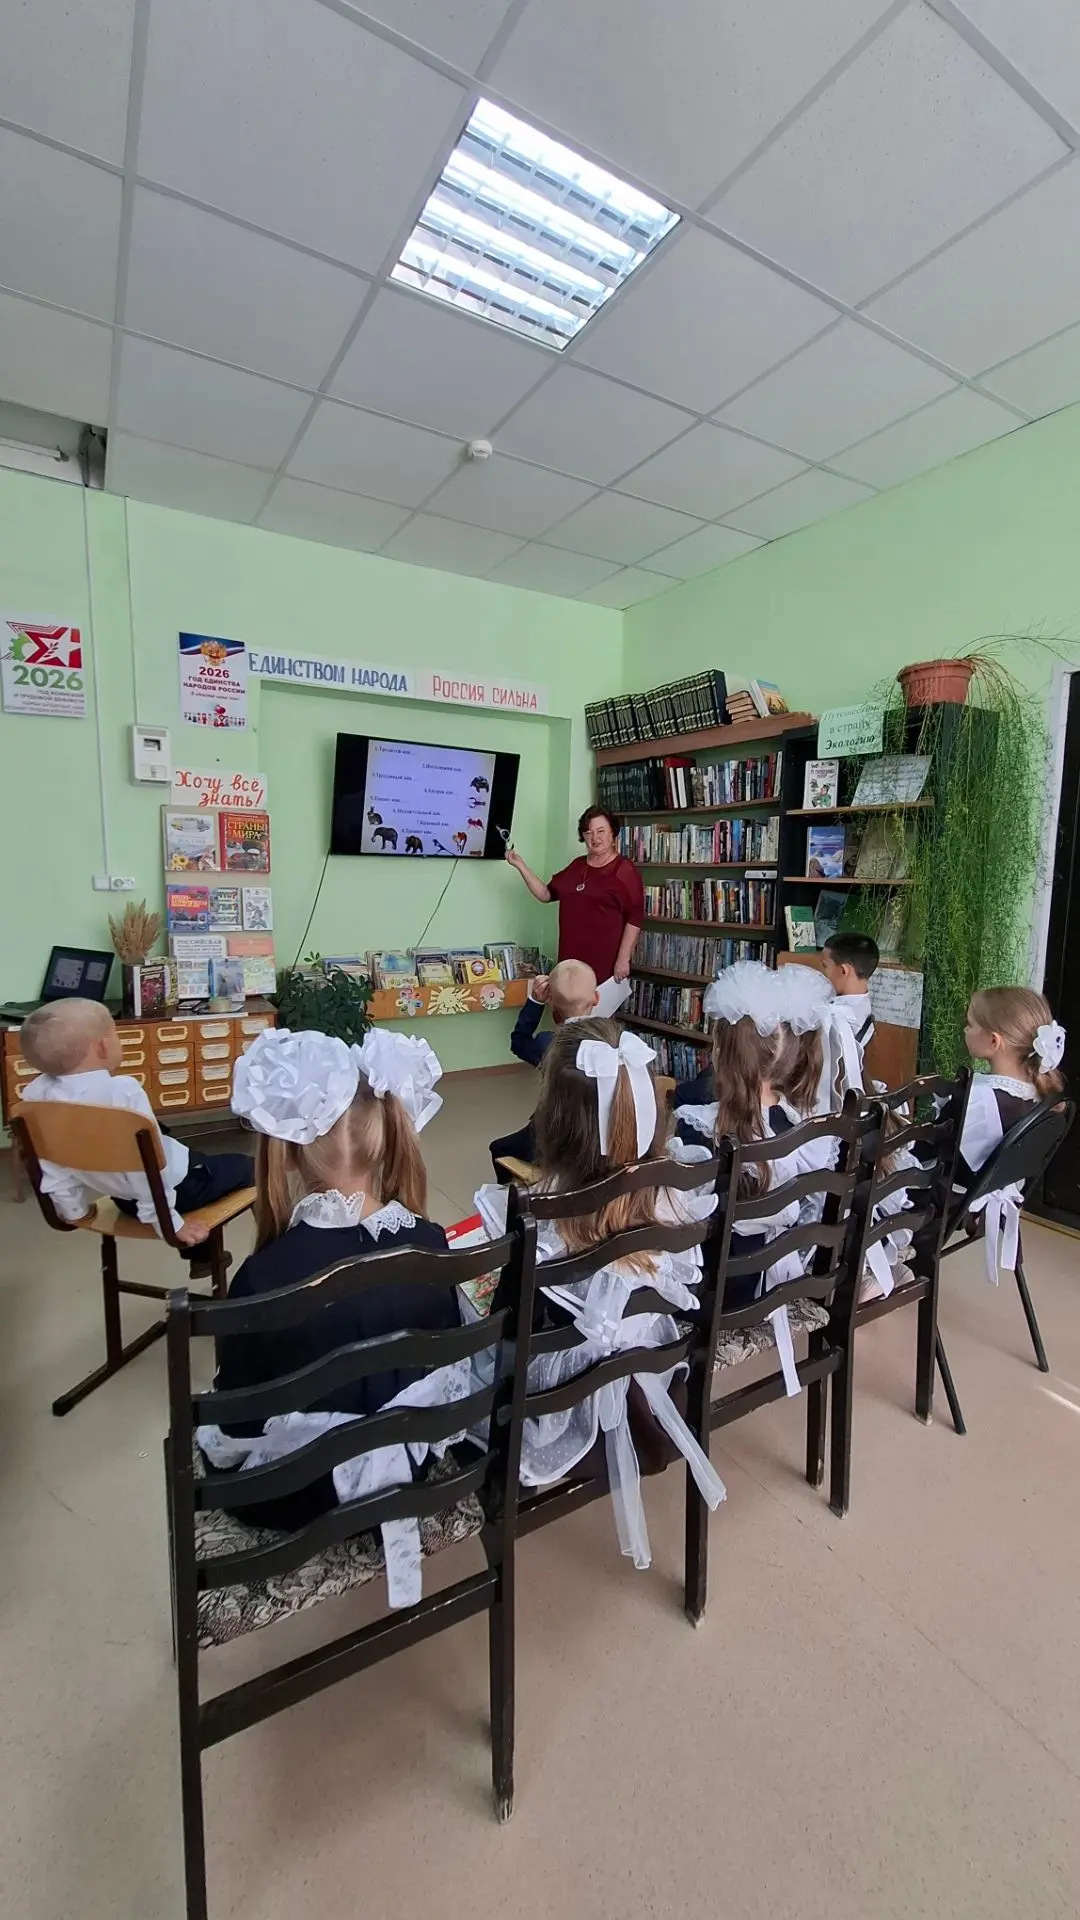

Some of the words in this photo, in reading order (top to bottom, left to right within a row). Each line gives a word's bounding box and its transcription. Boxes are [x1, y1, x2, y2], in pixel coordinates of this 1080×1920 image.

[12, 664, 84, 691] 2026
[198, 666, 230, 678] 2026
[188, 675, 203, 683] ГОД
[204, 677, 241, 687] ЕДИНСТВА
[248, 652, 345, 683] ЕДИНСТВОМ
[352, 667, 408, 692] НАРОДА
[432, 675, 485, 702] РОССИЯ
[492, 687, 538, 709] СИЛЬНА
[183, 682, 217, 690] НАРОДОВ
[218, 686, 246, 694] РОССИИ
[825, 734, 876, 750] Экологию
[175, 771, 223, 793] Хочу
[231, 774, 260, 792] всё
[199, 789, 264, 808] знать!
[228, 821, 265, 831] СТРАНЫ
[232, 829, 261, 839] МИРА
